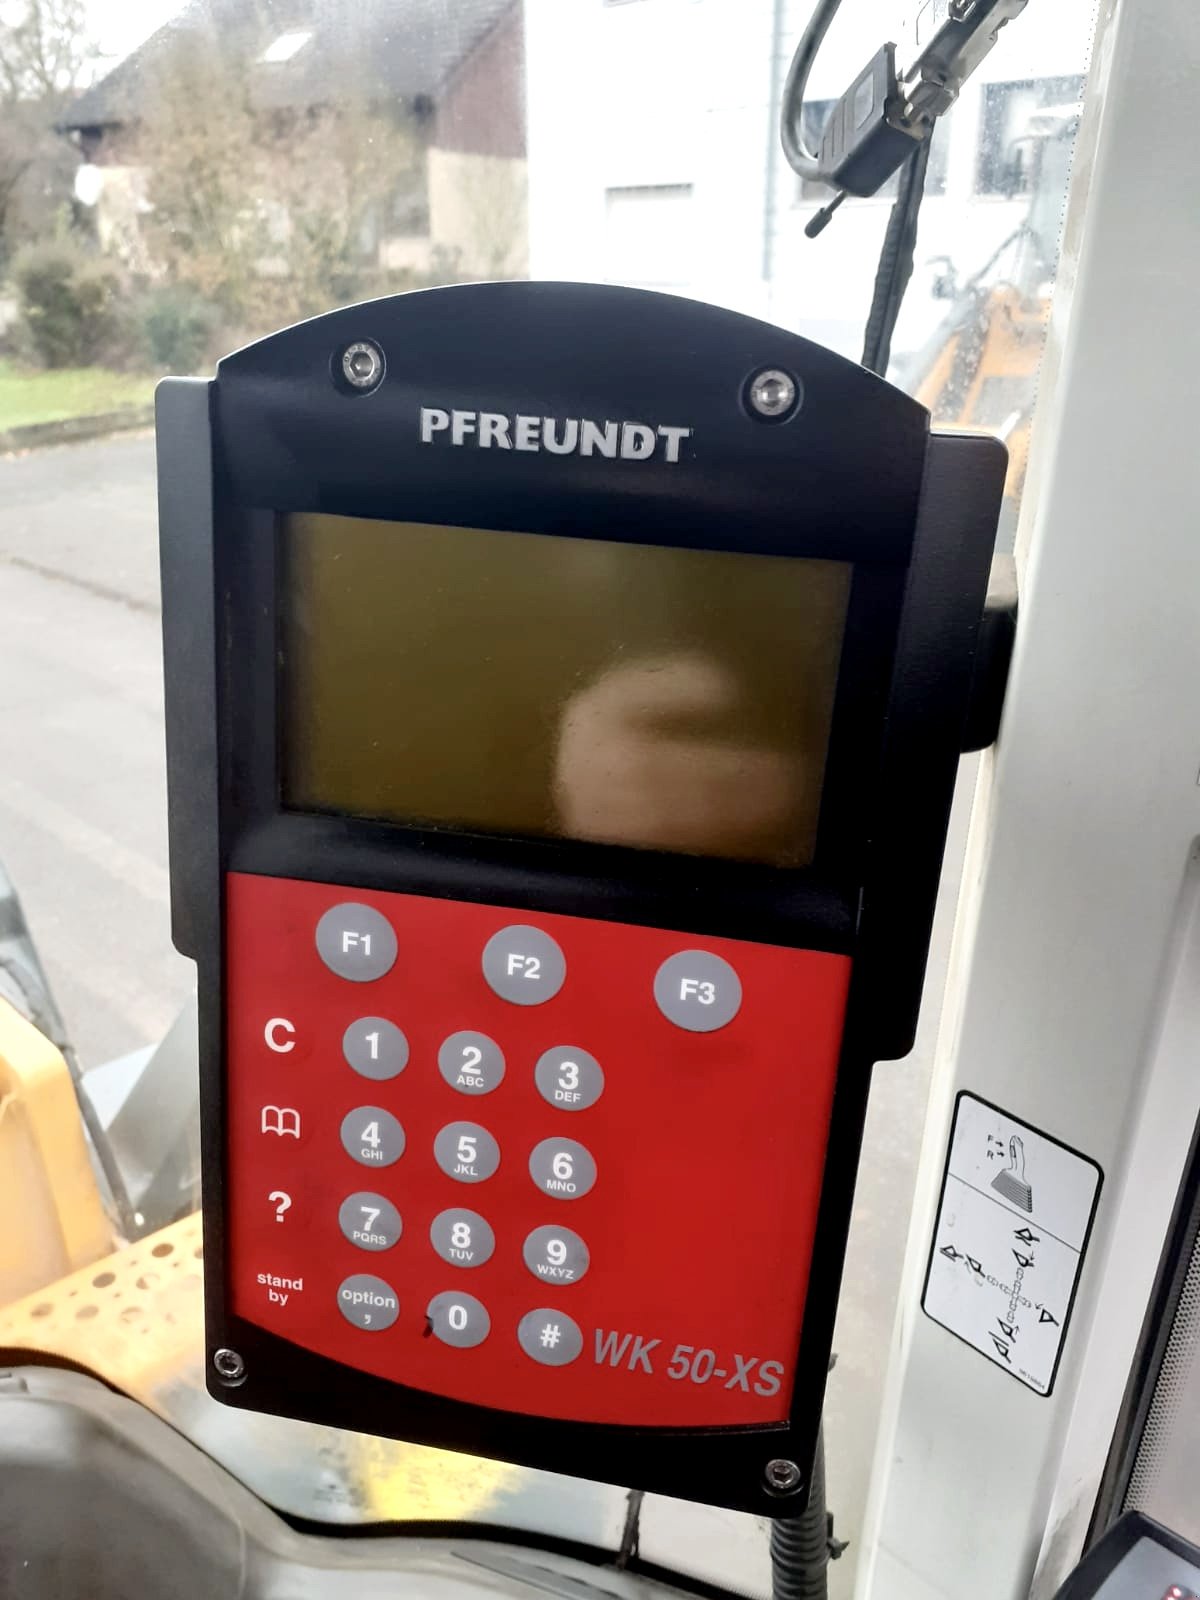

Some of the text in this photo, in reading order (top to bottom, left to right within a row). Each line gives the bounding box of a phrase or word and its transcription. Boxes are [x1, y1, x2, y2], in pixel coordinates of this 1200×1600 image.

[420, 407, 691, 463] PFREUNDT
[342, 931, 371, 956] F1
[507, 953, 541, 979] F2
[680, 978, 715, 1005] F3
[264, 1018, 296, 1053] C
[365, 1032, 380, 1059] 1
[461, 1046, 482, 1075] 2
[456, 1075, 485, 1088] ABC
[558, 1061, 579, 1090] 3
[554, 1090, 581, 1103] DEF
[361, 1121, 381, 1149] 4
[361, 1149, 383, 1161] GHI
[457, 1136, 477, 1164] 5
[453, 1164, 478, 1176] JKL
[552, 1152, 573, 1180] 6
[546, 1179, 577, 1193] MNO
[268, 1191, 292, 1223] ?
[360, 1206, 381, 1231] 7
[353, 1232, 387, 1245] PQRS
[451, 1222, 471, 1249] 8
[449, 1248, 474, 1262] TUV
[547, 1239, 567, 1265] 9
[257, 1273, 303, 1291] stand
[537, 1264, 574, 1280] WXYZ
[269, 1289, 289, 1306] by
[342, 1288, 396, 1309] option
[449, 1305, 467, 1330] 0
[540, 1324, 561, 1348] #
[595, 1328, 785, 1397] WK 50-XS
